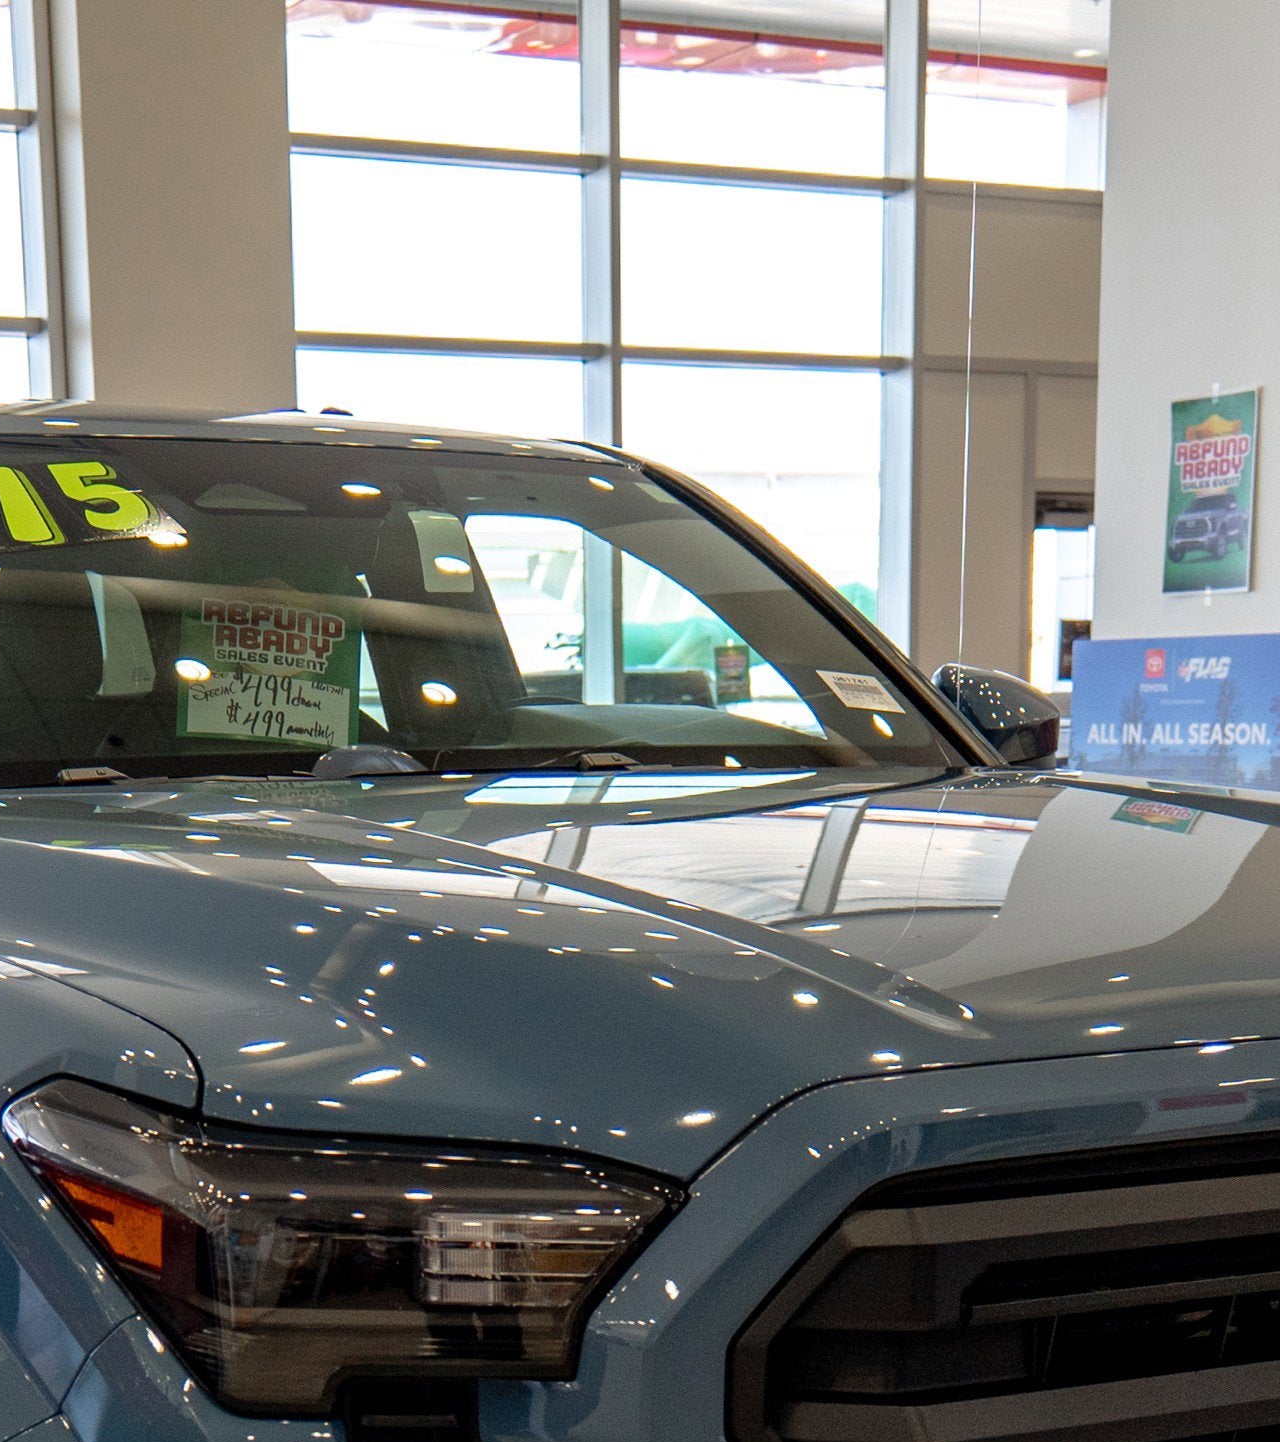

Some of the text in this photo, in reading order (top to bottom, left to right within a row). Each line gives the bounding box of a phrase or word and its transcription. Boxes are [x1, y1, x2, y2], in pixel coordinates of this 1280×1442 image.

[1176, 436, 1250, 463] REFUND
[1182, 456, 1244, 480] READY
[202, 600, 344, 639] REFUND
[215, 625, 331, 659] READY
[216, 649, 327, 673] SALES EVENT
[1184, 656, 1232, 682] FLAG
[1087, 722, 1272, 745] ALL IN. ALL SEASON.
